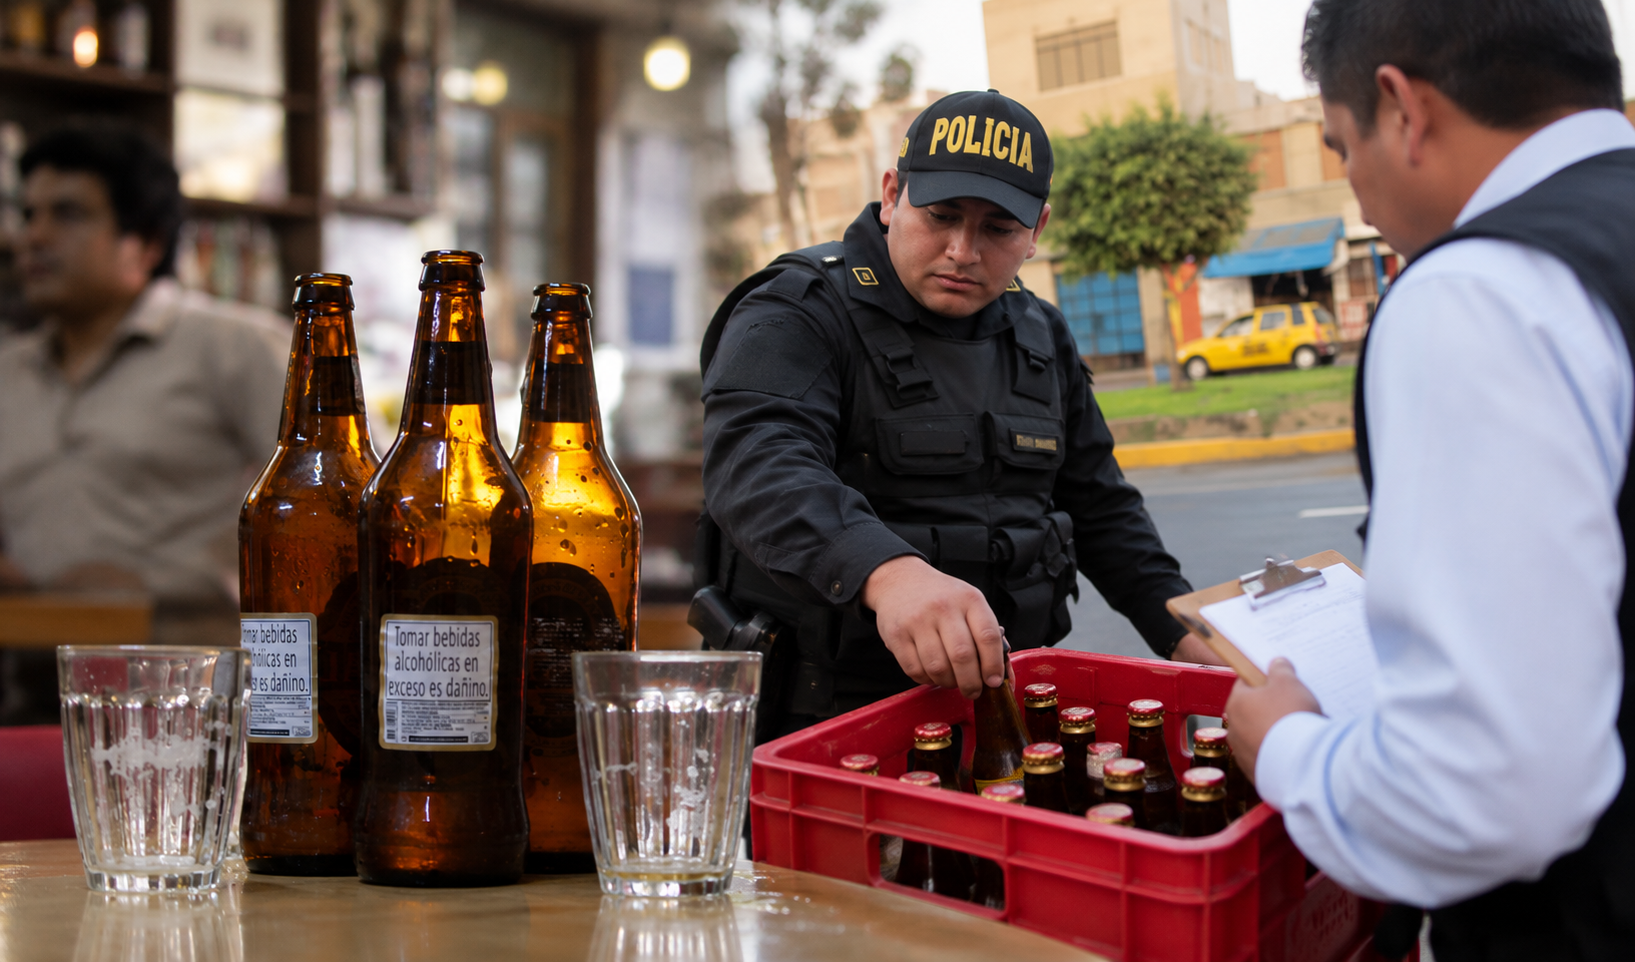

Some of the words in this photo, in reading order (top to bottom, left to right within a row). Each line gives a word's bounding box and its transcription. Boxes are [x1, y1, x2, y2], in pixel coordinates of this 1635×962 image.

[929, 115, 1033, 173] POLICIA
[260, 623, 297, 644] bebidas
[394, 626, 429, 647] Tomar
[433, 626, 480, 647] bebidas
[284, 653, 297, 668] en
[394, 650, 460, 672] alcohólicas
[464, 657, 478, 672] en
[259, 677, 268, 692] es
[270, 672, 308, 692] dañino.
[388, 680, 426, 697] exceso
[429, 682, 442, 697] es
[446, 677, 488, 697] dañino.
